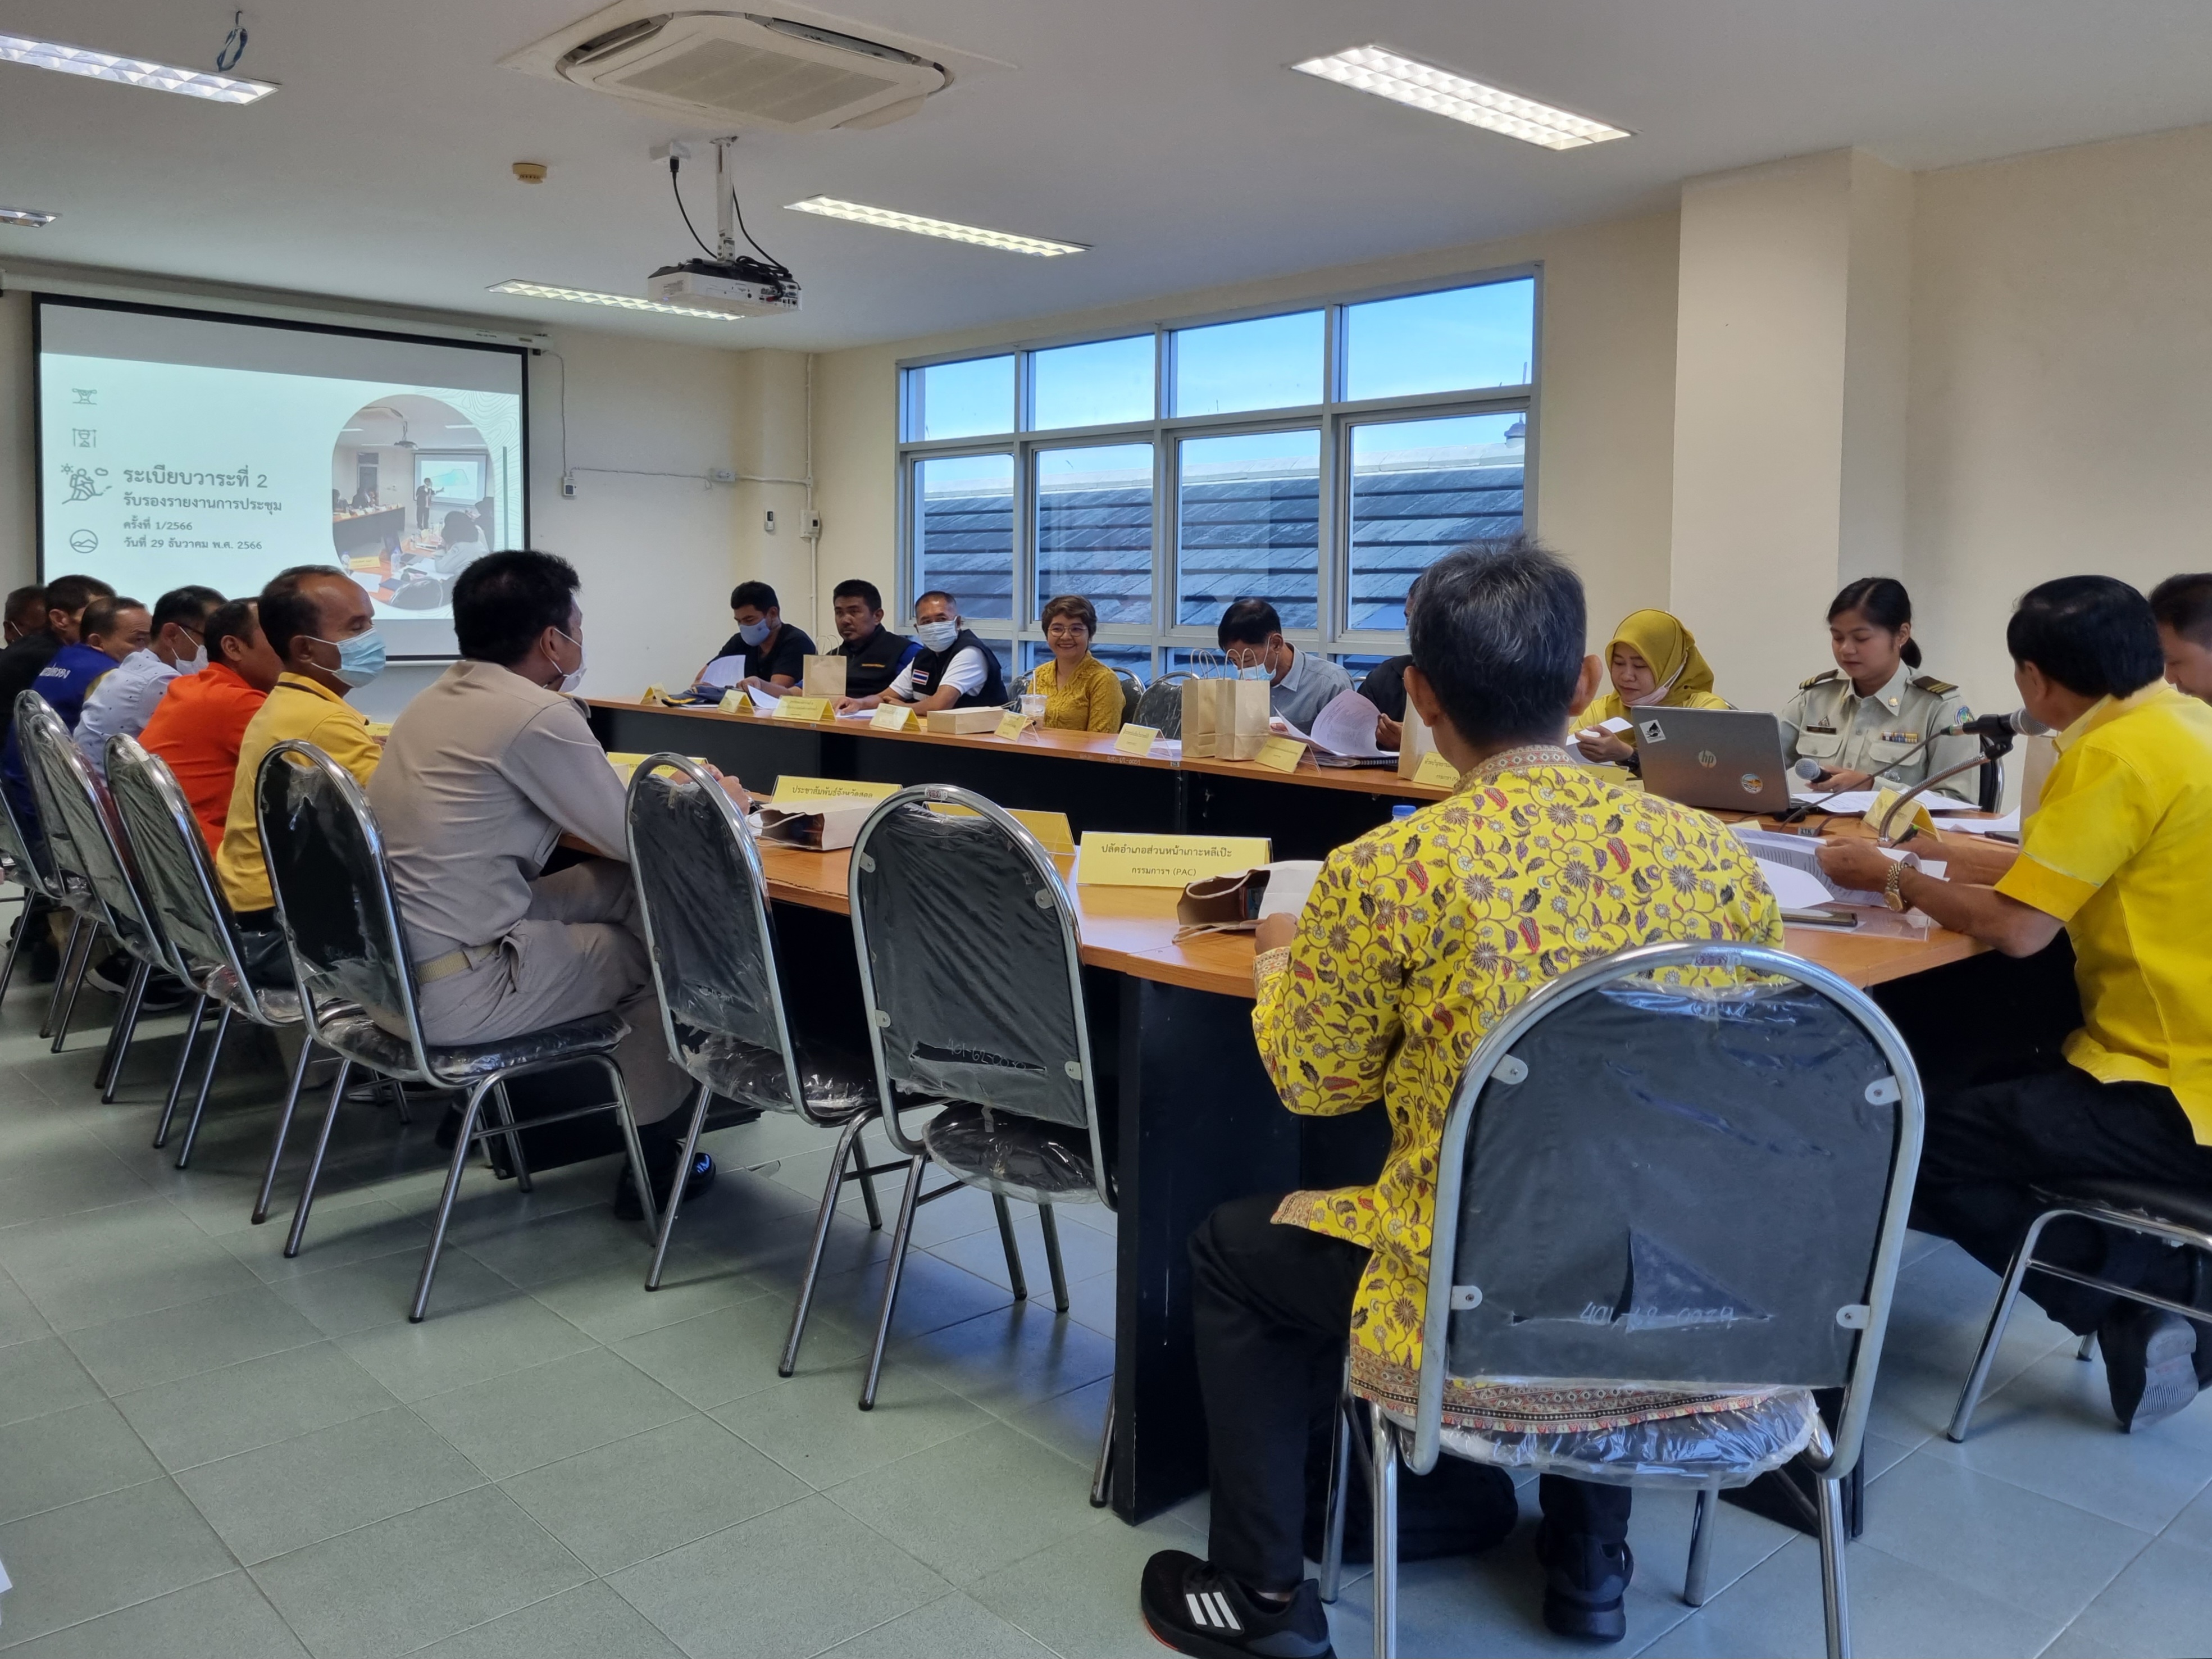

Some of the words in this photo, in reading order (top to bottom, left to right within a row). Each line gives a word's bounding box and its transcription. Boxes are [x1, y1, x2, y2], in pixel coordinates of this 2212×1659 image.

[123, 464, 249, 488] ระเบียบวาระที่
[257, 474, 268, 488] 2
[123, 492, 282, 515] รับรองรายงานการประชุม
[123, 515, 151, 530] ครั้งที่
[156, 521, 193, 530] 1/2566
[123, 534, 147, 548] วันที่
[151, 539, 165, 548] 29
[169, 537, 208, 549] ธันวาคม
[212, 540, 234, 549] พ.ศ.
[237, 541, 262, 549] 2566
[1701, 750, 1714, 768] hp
[792, 785, 873, 798] ประชาสัมพันธ์จังหวัดสตล
[1101, 843, 1232, 857] ปลัดอำเภอส่วนหน้าเกาะหลีเป๊ะ
[1173, 867, 1196, 876] (PAC)
